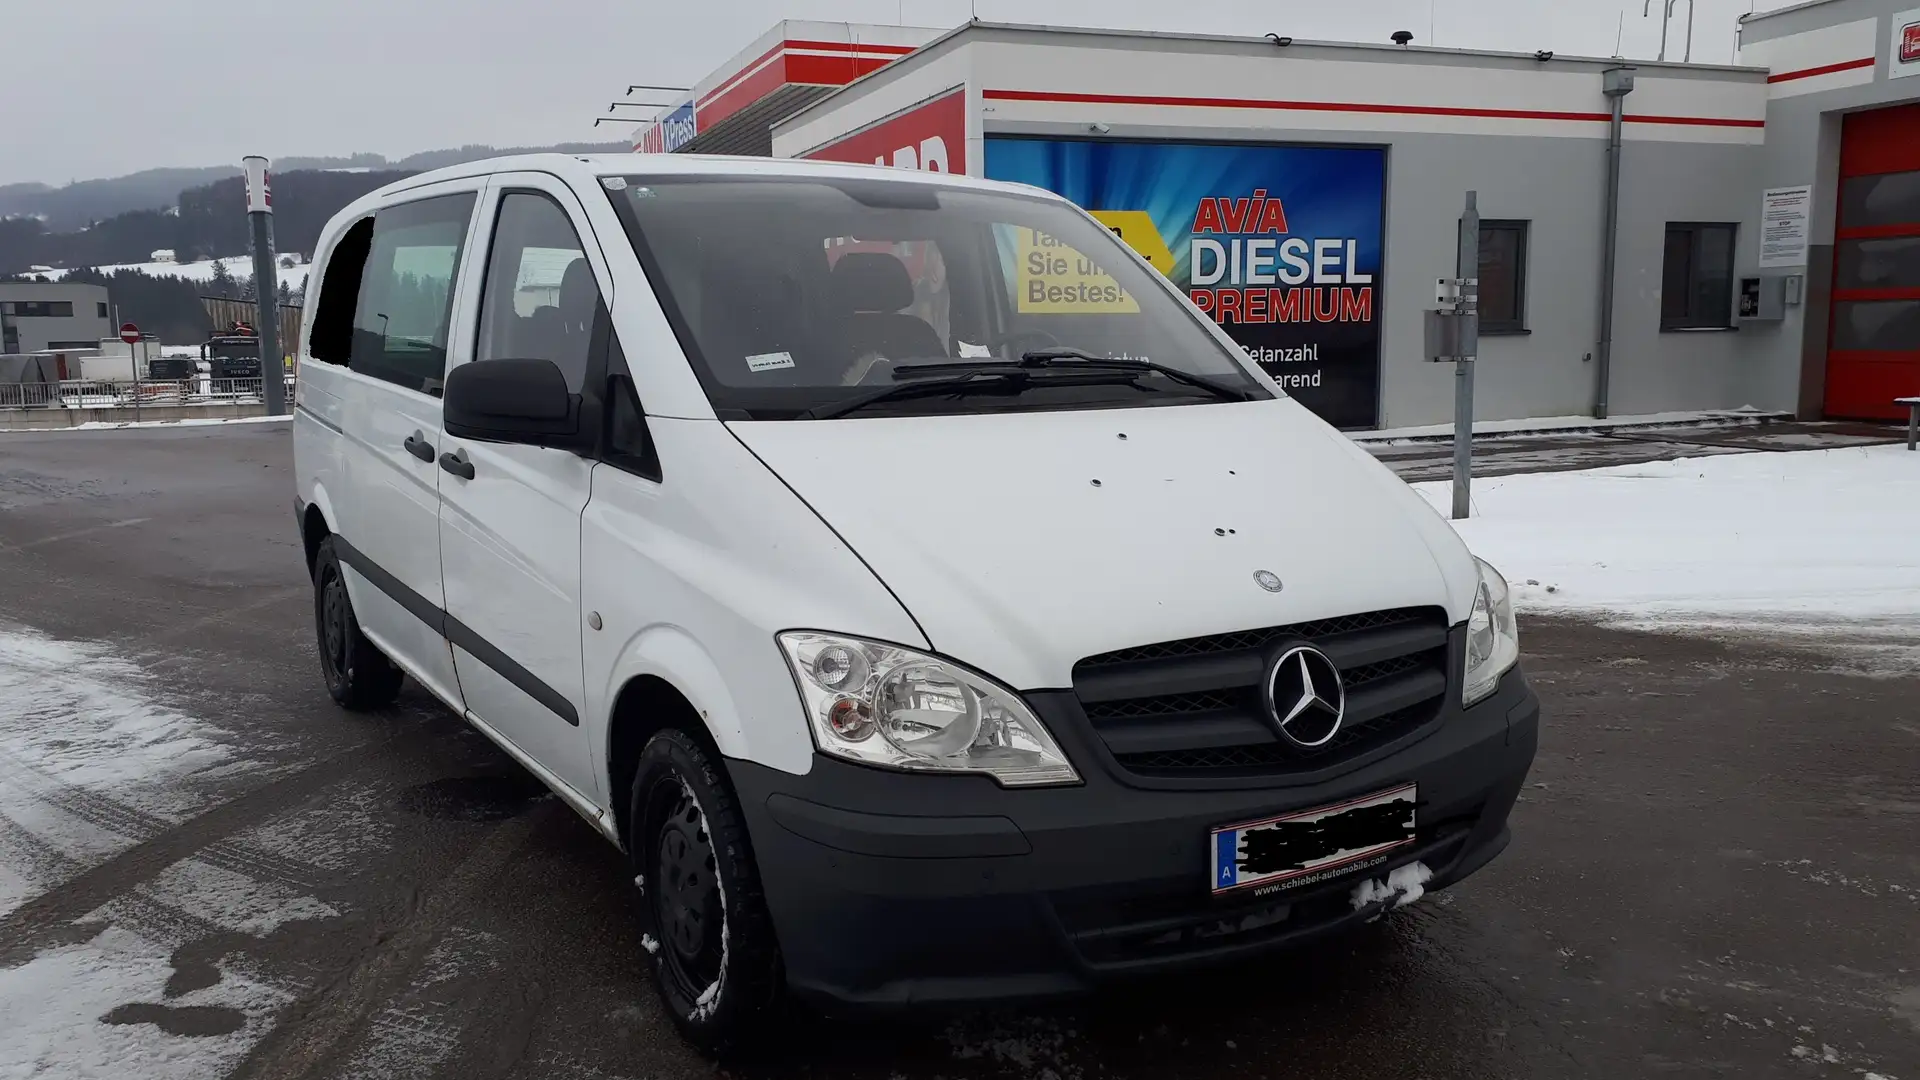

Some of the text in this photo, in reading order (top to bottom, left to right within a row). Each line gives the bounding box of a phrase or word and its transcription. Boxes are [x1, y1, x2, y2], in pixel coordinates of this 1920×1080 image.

[1192, 189, 1288, 234] AVIA
[1027, 251, 1068, 276] Sie
[1190, 238, 1372, 285] DIESEL
[1028, 280, 1124, 303] Bestes!
[1190, 287, 1372, 324] PREMIUM
[1222, 866, 1231, 879] A
[1254, 854, 1387, 896] www.schiebel-automobile.com
